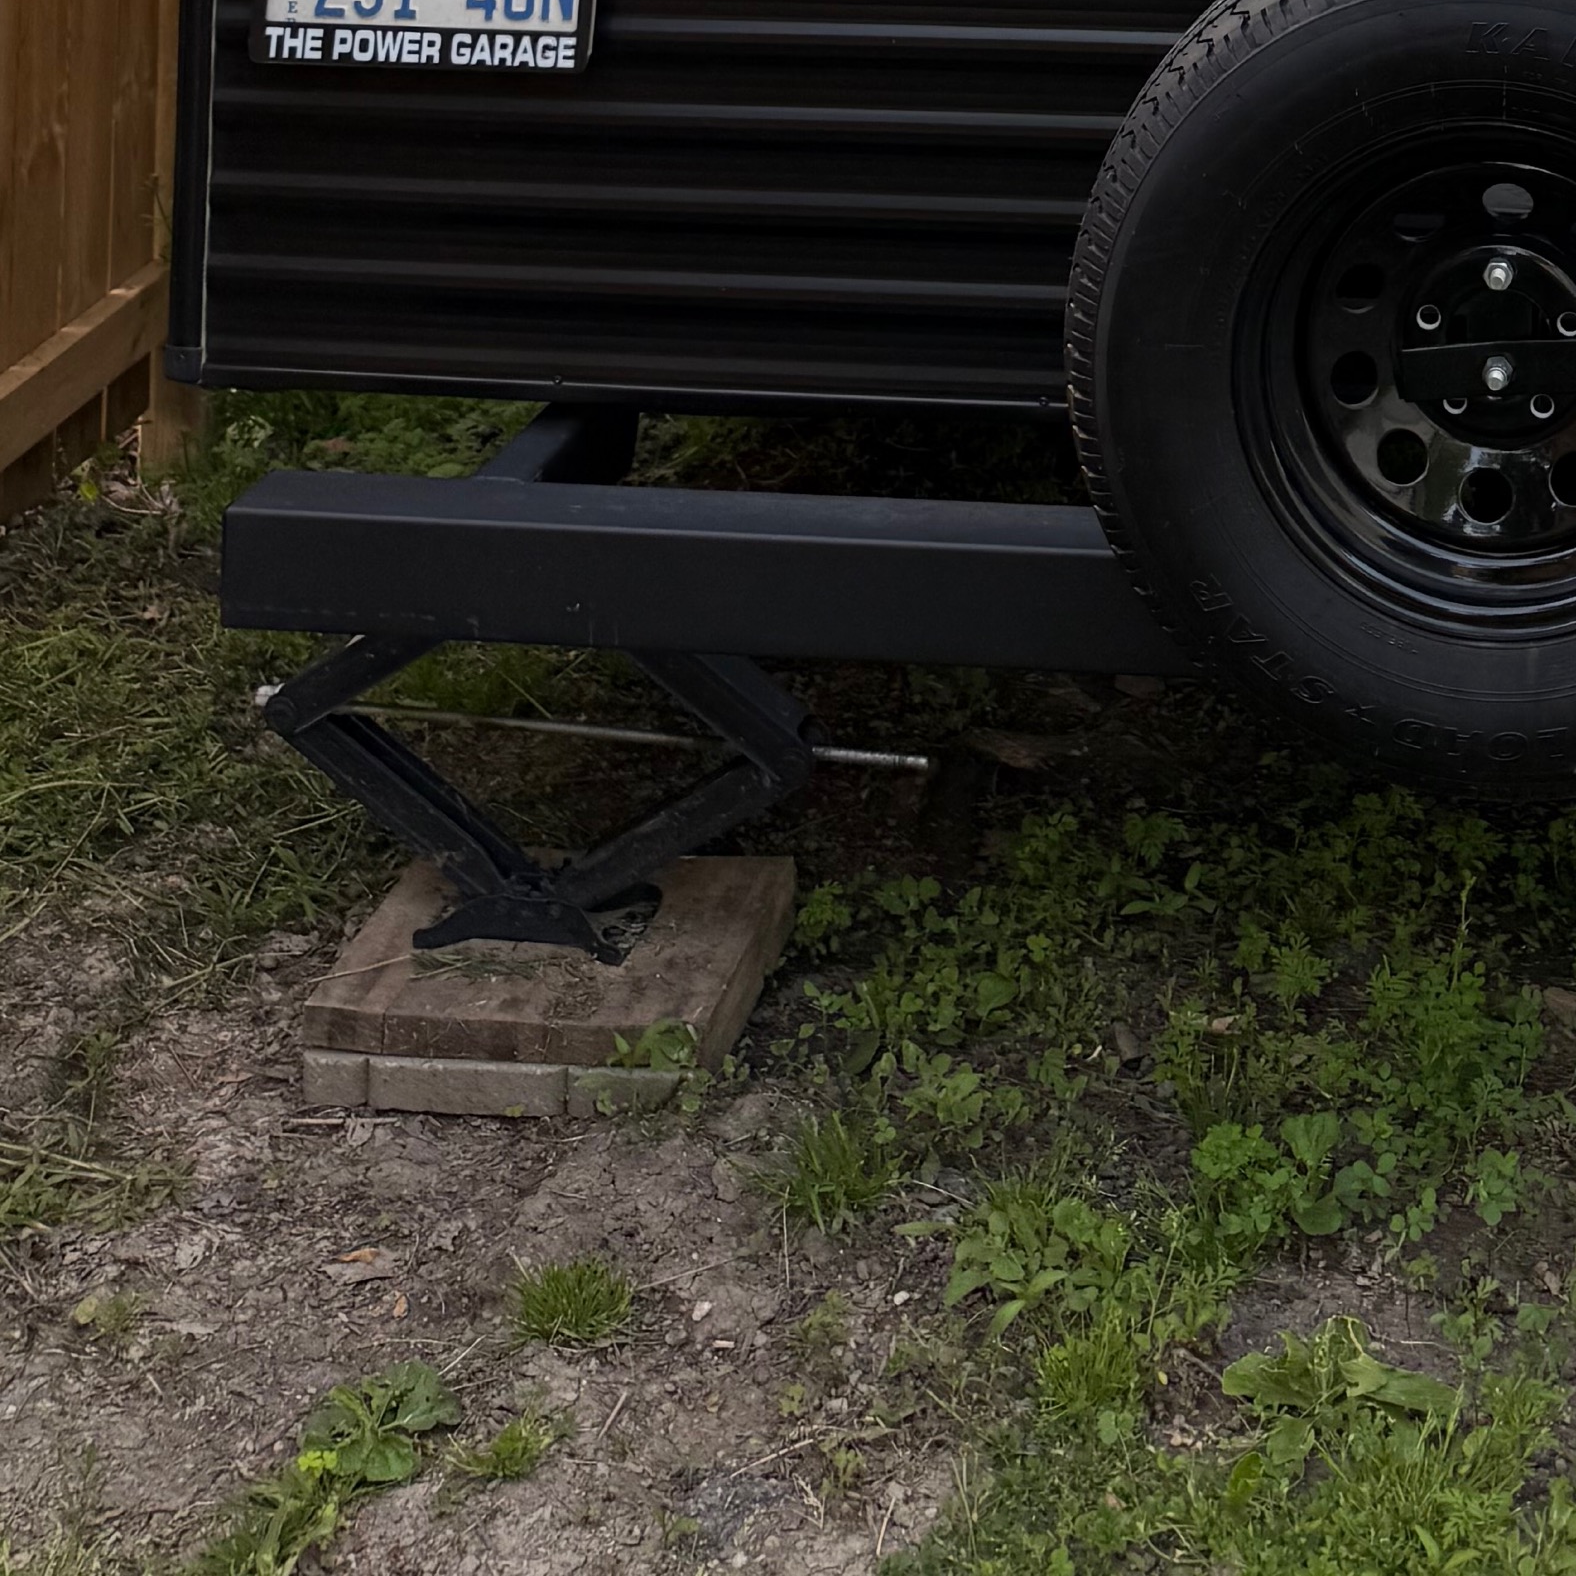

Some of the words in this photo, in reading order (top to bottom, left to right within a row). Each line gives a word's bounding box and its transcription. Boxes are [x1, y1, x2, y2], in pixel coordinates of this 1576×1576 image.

[265, 25, 324, 60] THE
[331, 28, 442, 65] POWER
[450, 32, 578, 69] GARAGE
